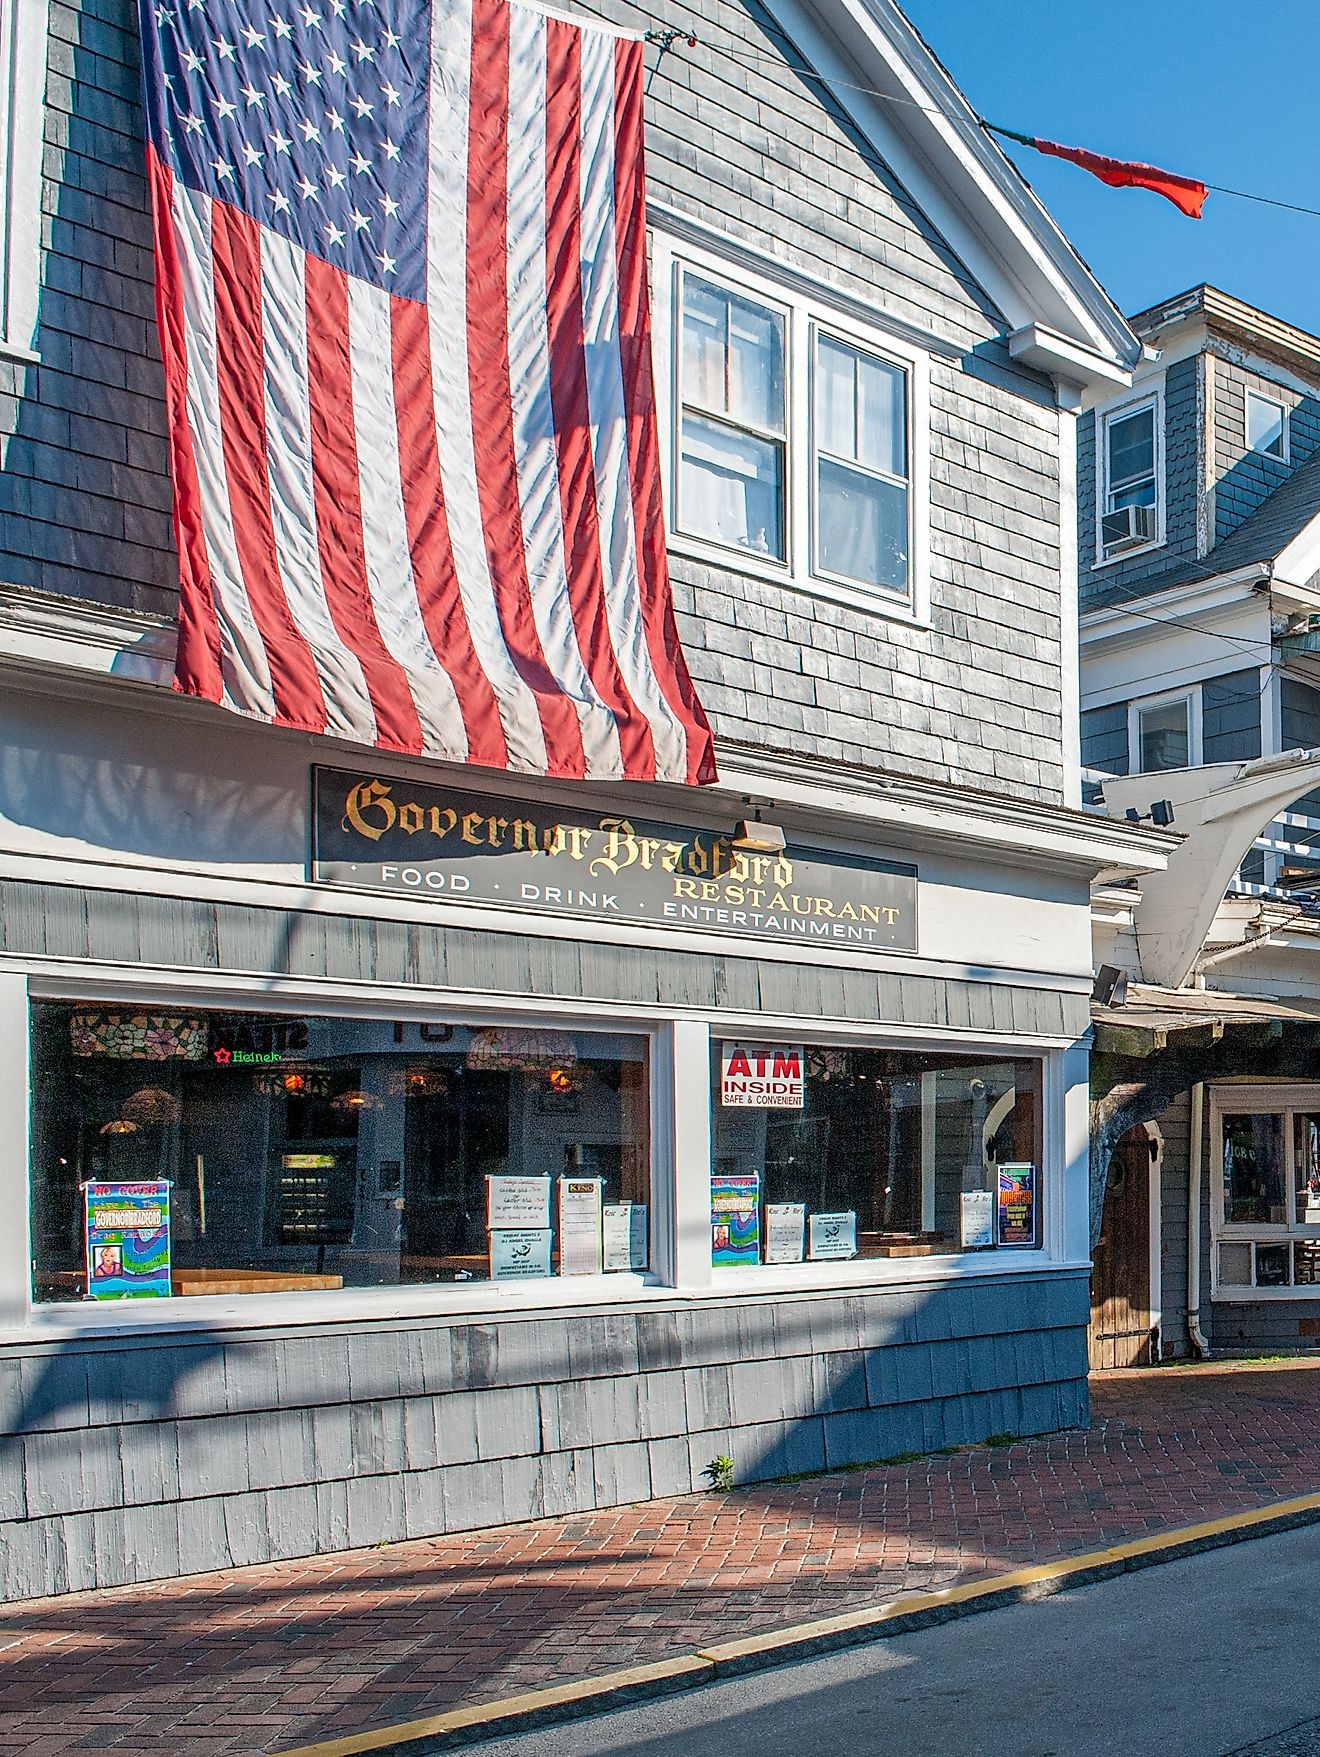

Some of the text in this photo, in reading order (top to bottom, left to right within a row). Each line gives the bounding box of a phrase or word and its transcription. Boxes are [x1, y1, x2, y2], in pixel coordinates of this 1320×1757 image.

[341, 778, 793, 889] Governor Bradford
[381, 865, 619, 910] FOOD DRINK
[673, 877, 900, 925] RESTAURANT
[663, 902, 877, 941] ENTERTAINMENT
[231, 1050, 281, 1062] Heinek
[726, 1049, 801, 1079] ATM
[724, 1080, 803, 1095] INSIDE
[724, 1094, 803, 1106] SAFE & CONVENIENT
[570, 1184, 593, 1192] KENO
